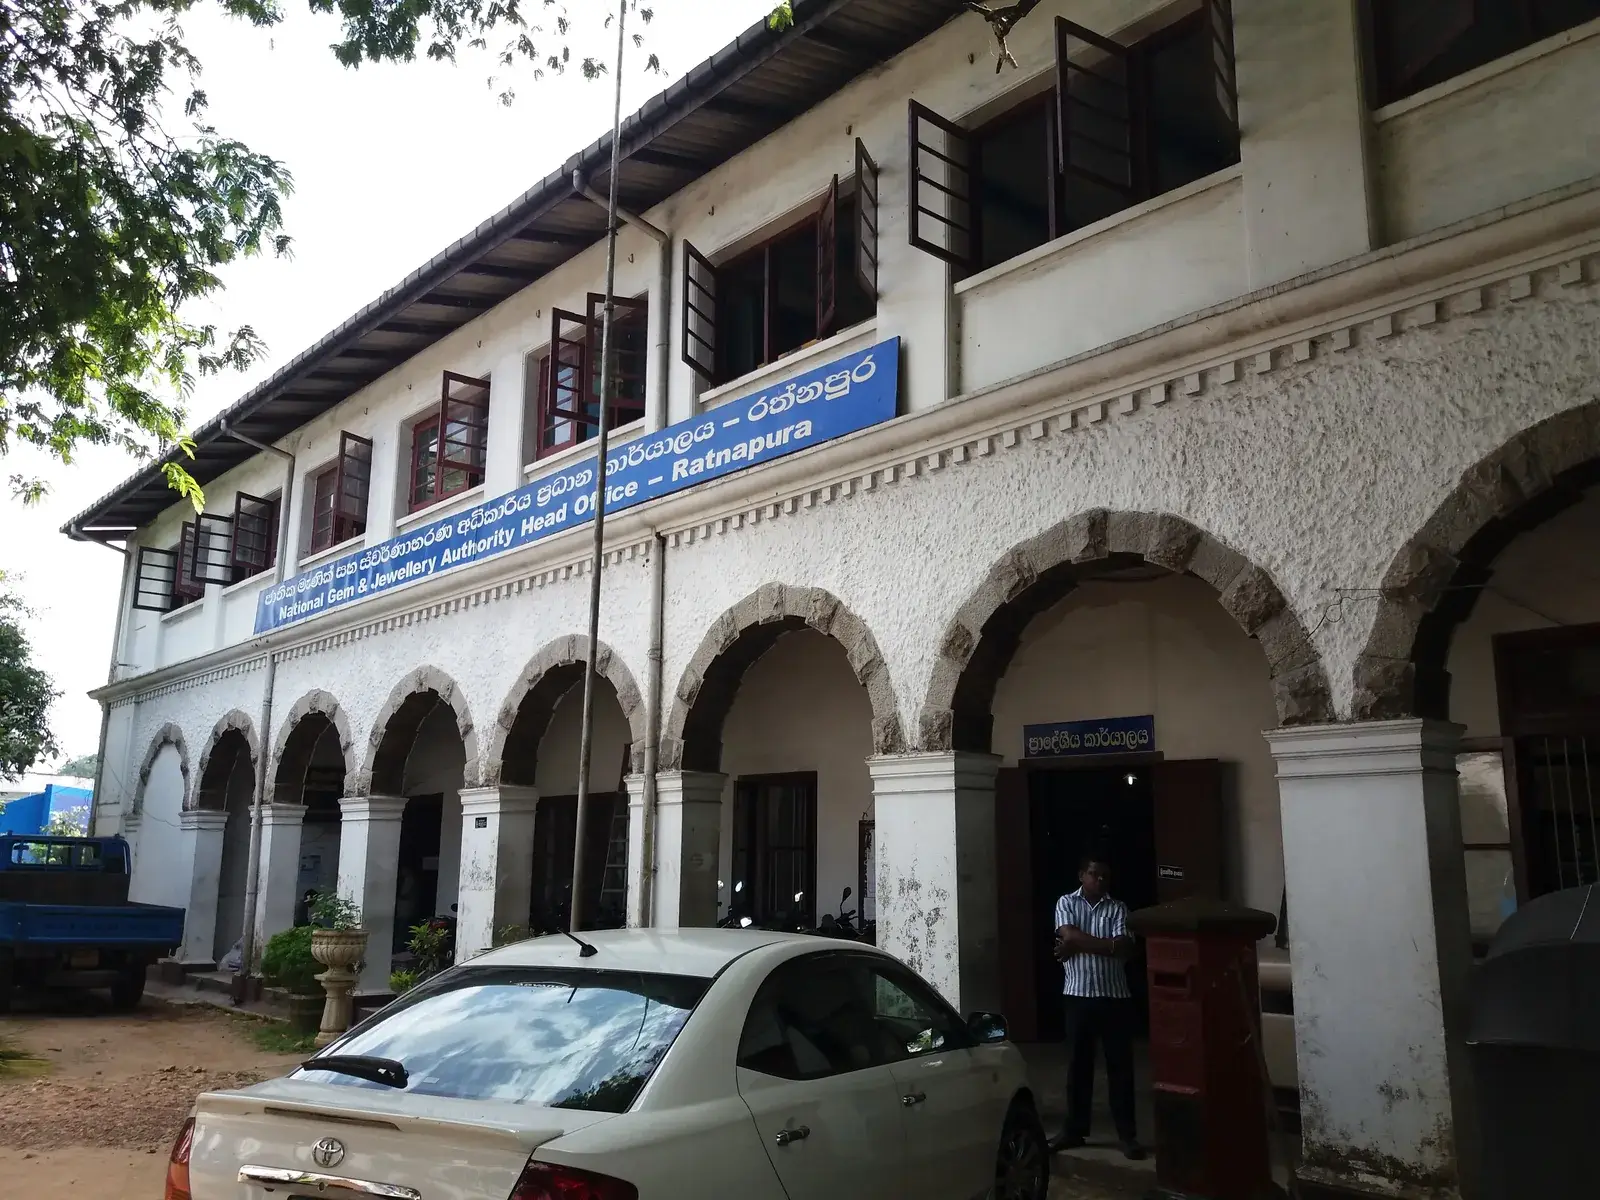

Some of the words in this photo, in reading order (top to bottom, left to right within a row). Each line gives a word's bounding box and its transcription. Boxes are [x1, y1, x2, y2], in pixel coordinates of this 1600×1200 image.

[264, 585, 296, 605] ජාතික
[298, 565, 335, 593] මැණික්
[336, 561, 358, 579] සහ
[360, 523, 453, 570] ස්වර්ණාභරණ
[457, 493, 531, 536] අධිකාරිය
[537, 469, 593, 507] ප්‍රධාන
[748, 354, 876, 422] රත්නපුර
[279, 592, 324, 621] National
[328, 585, 355, 604] Gem
[357, 578, 368, 594] &
[371, 556, 437, 589] Jewellery
[441, 526, 516, 566] Authority
[520, 502, 568, 537] Head
[574, 481, 639, 515] Ofice
[672, 419, 813, 482] Ratnapura
